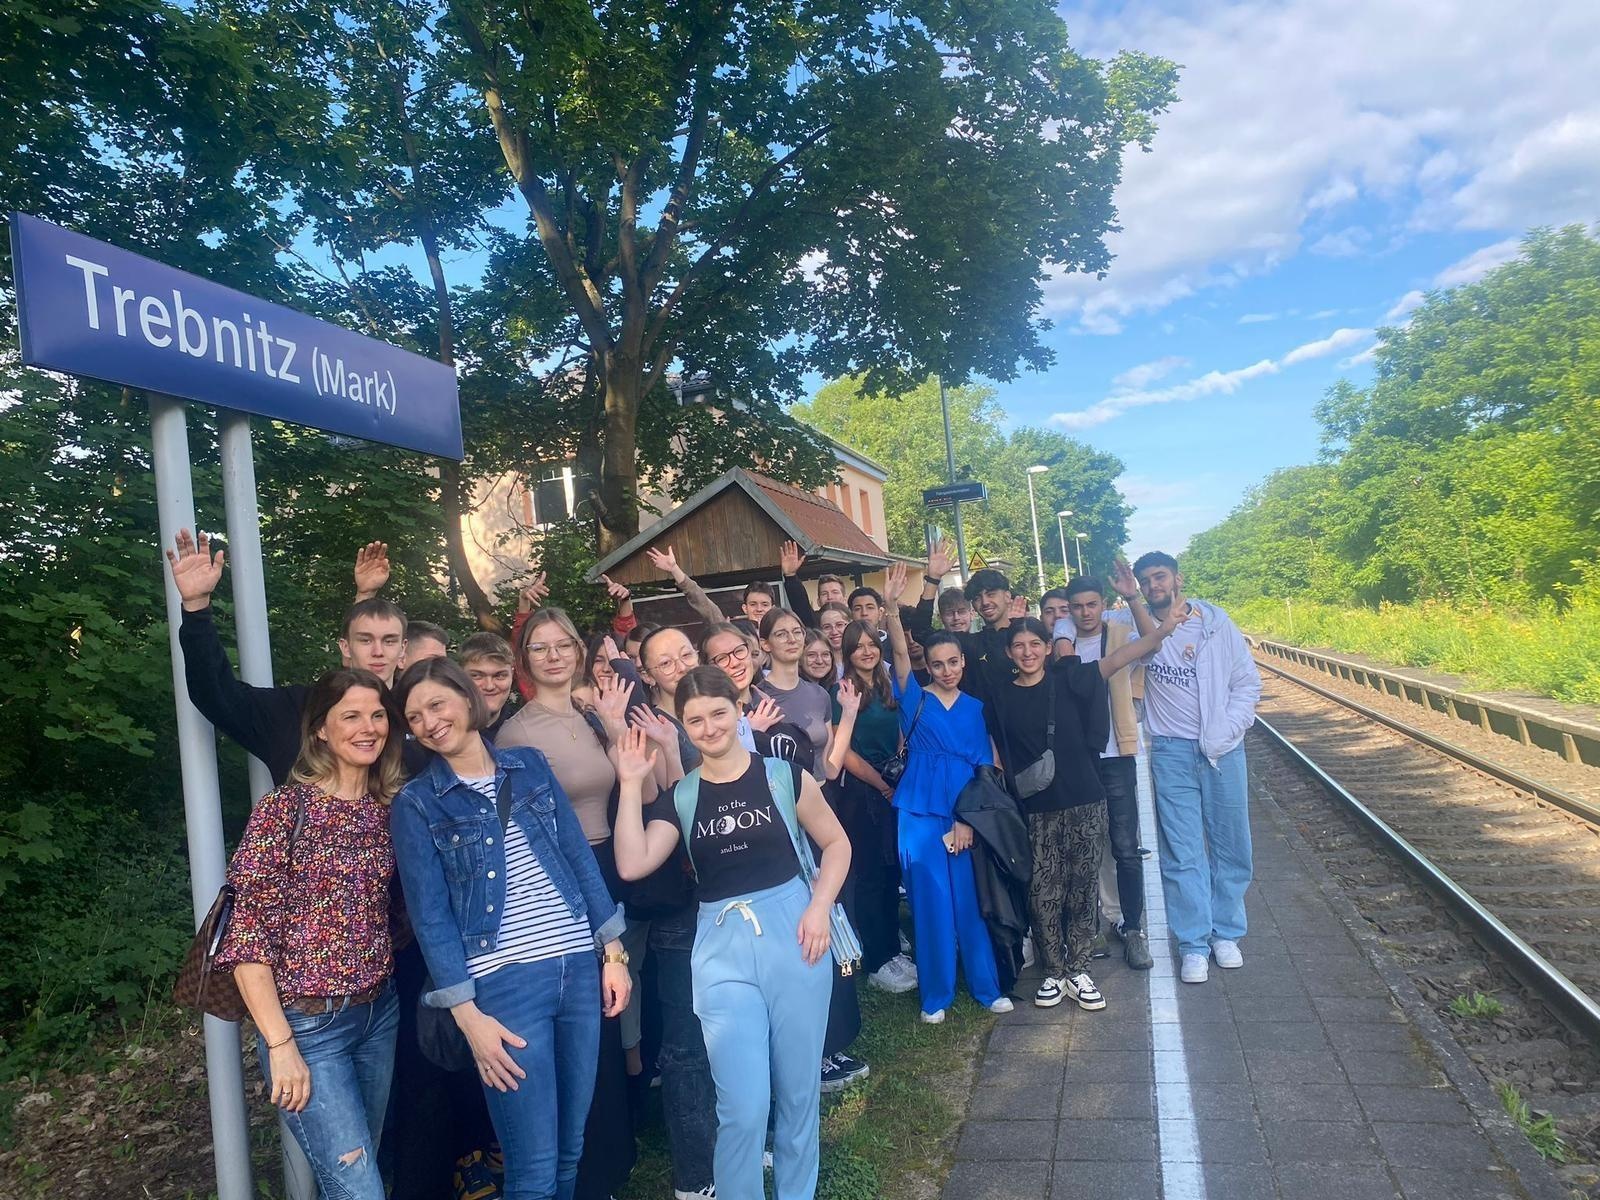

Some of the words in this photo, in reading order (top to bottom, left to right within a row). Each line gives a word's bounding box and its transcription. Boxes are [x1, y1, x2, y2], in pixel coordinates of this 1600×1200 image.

[66, 254, 301, 384] Trebnitz
[312, 347, 397, 416] (Mark)
[718, 804, 728, 812] to
[731, 800, 746, 808] the
[696, 806, 772, 838] MOON
[720, 844, 733, 854] and
[733, 842, 748, 851] back
